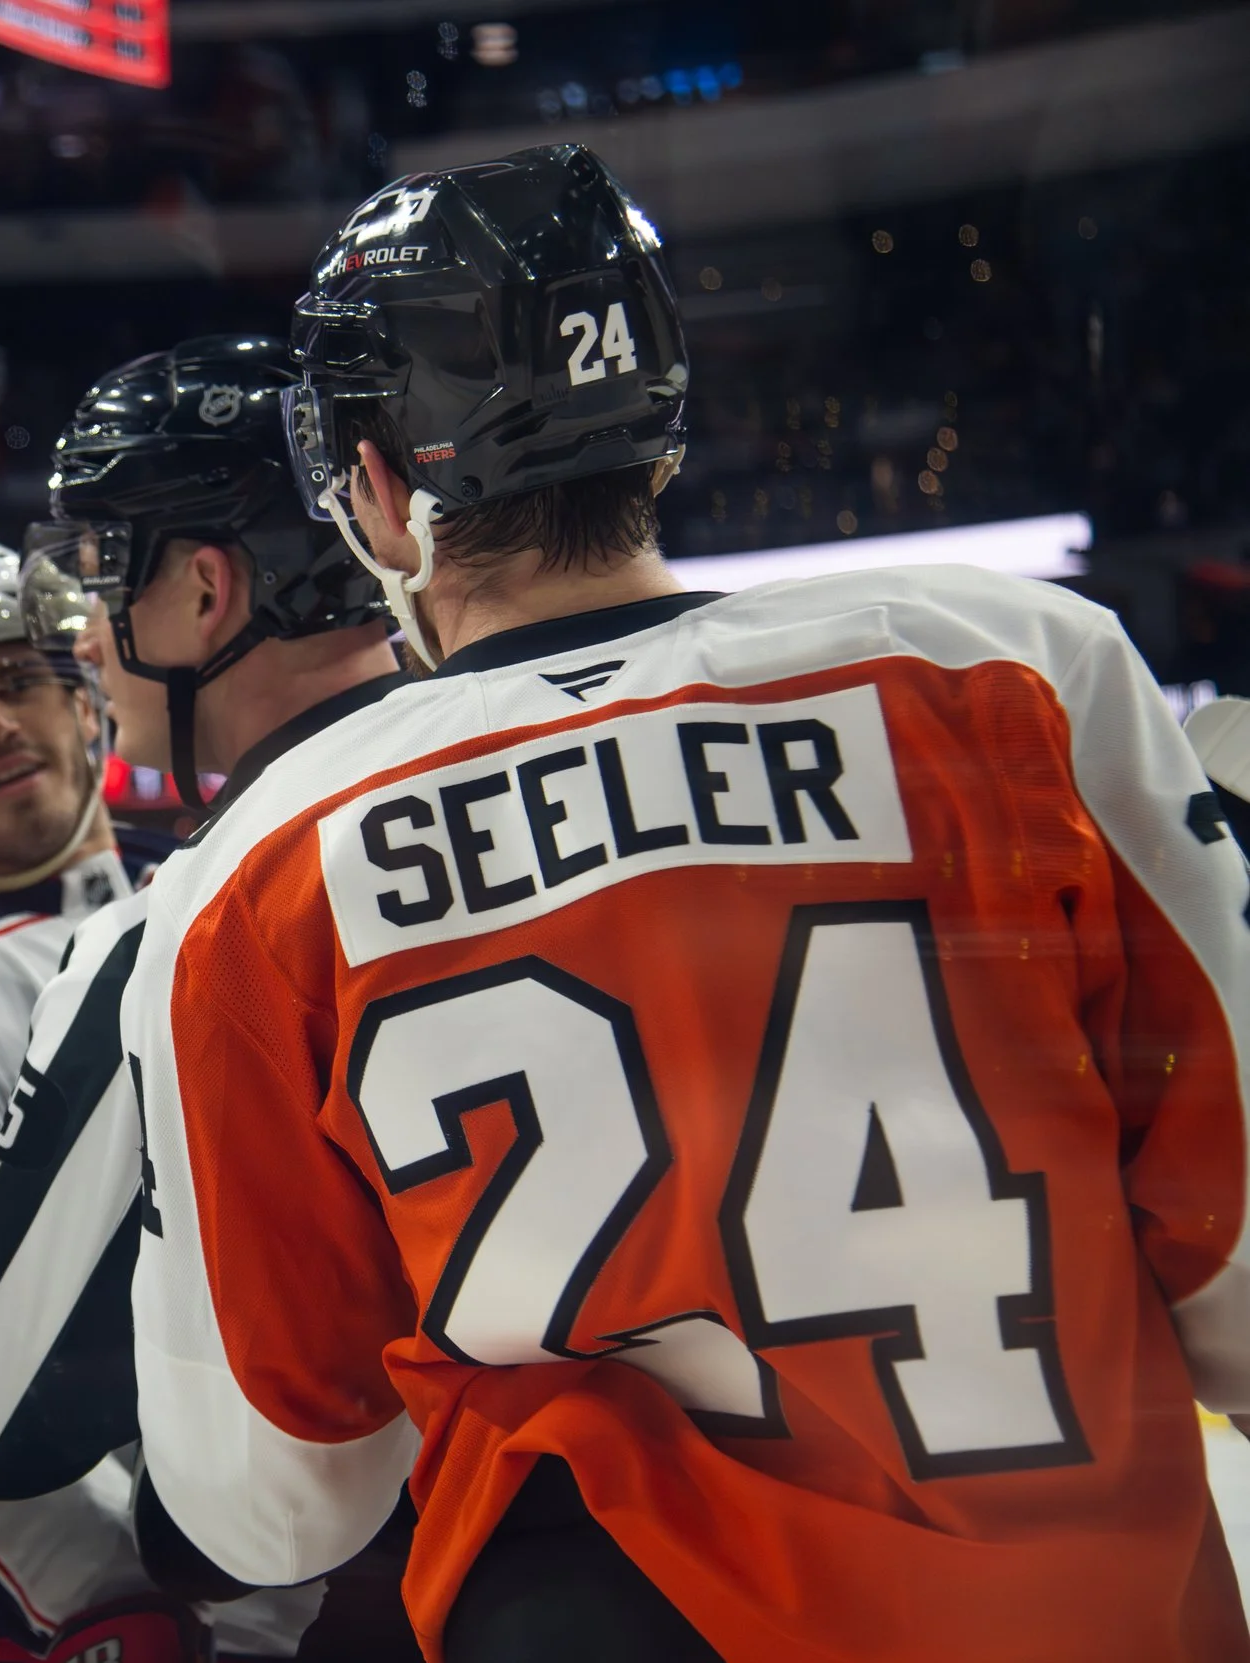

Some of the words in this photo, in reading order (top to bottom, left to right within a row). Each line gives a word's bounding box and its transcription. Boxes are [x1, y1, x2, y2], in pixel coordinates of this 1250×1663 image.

[559, 302, 638, 387] 24
[413, 441, 454, 454] PHILADELPHIA
[416, 447, 456, 464] FLYERS
[359, 718, 859, 928] SEELER
[347, 898, 1095, 1481] 24
